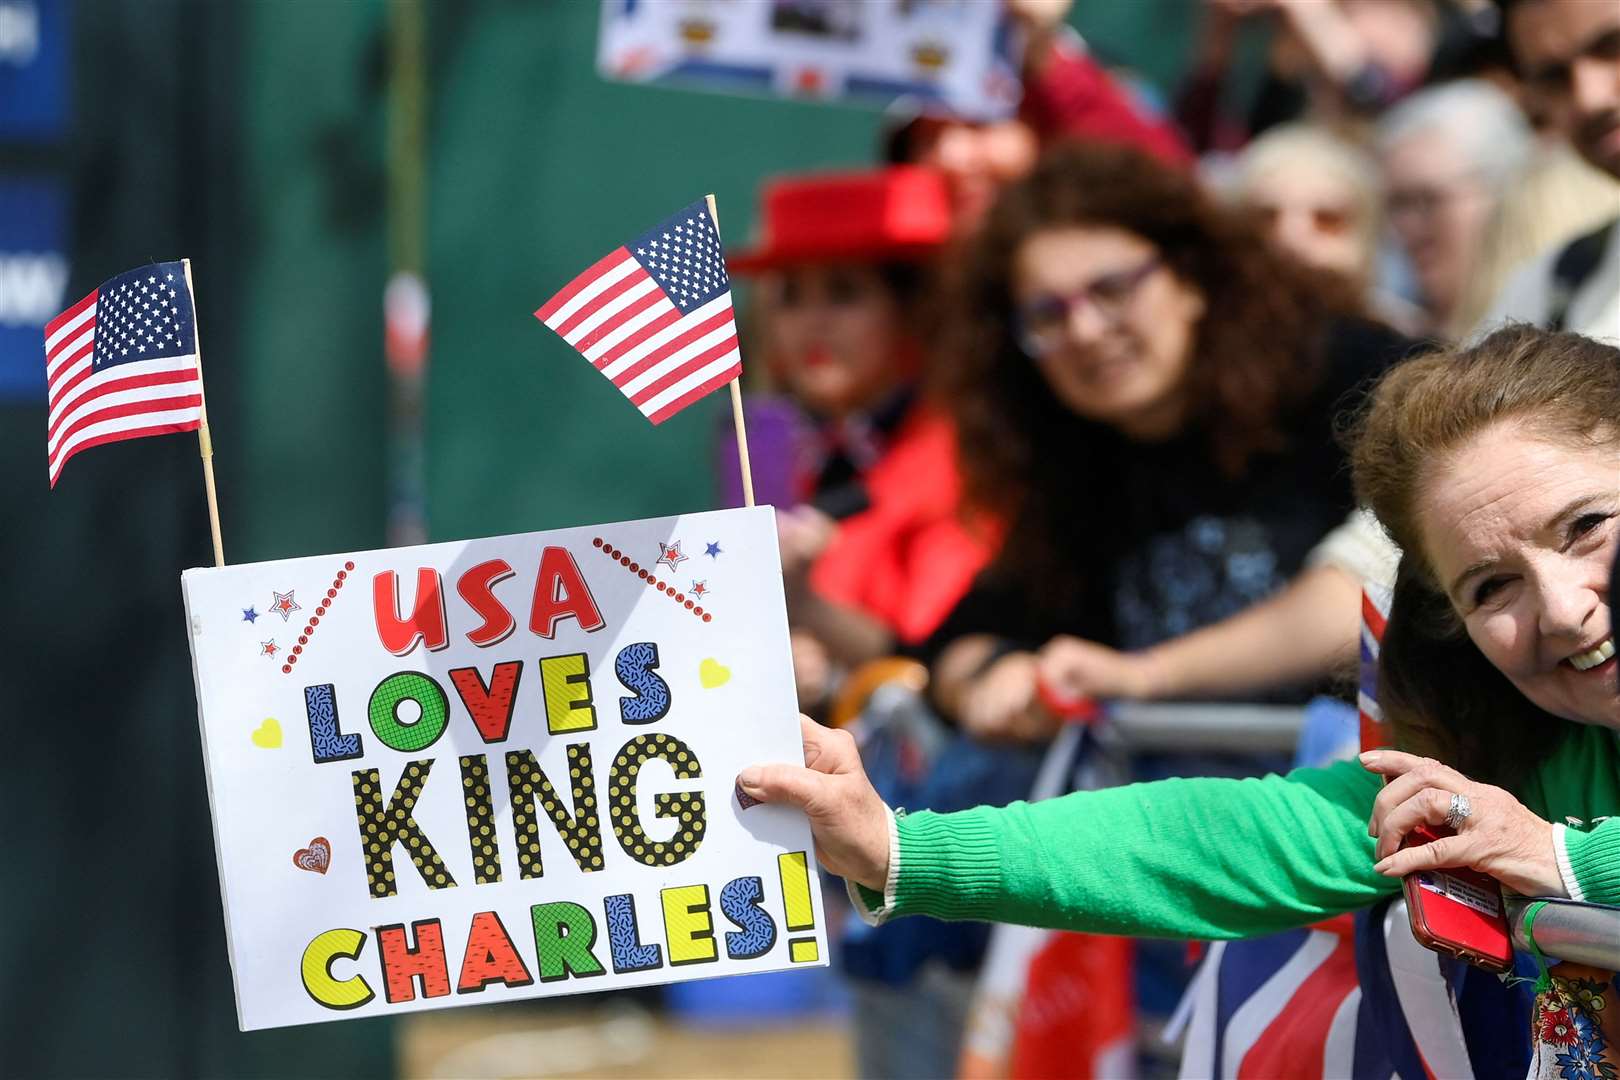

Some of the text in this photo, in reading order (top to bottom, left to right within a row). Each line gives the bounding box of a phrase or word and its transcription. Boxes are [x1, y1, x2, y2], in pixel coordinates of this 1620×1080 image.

[373, 546, 606, 656] USA
[304, 642, 673, 763] LOVES
[351, 733, 707, 899] KING
[300, 851, 819, 1010] CHARLES!
